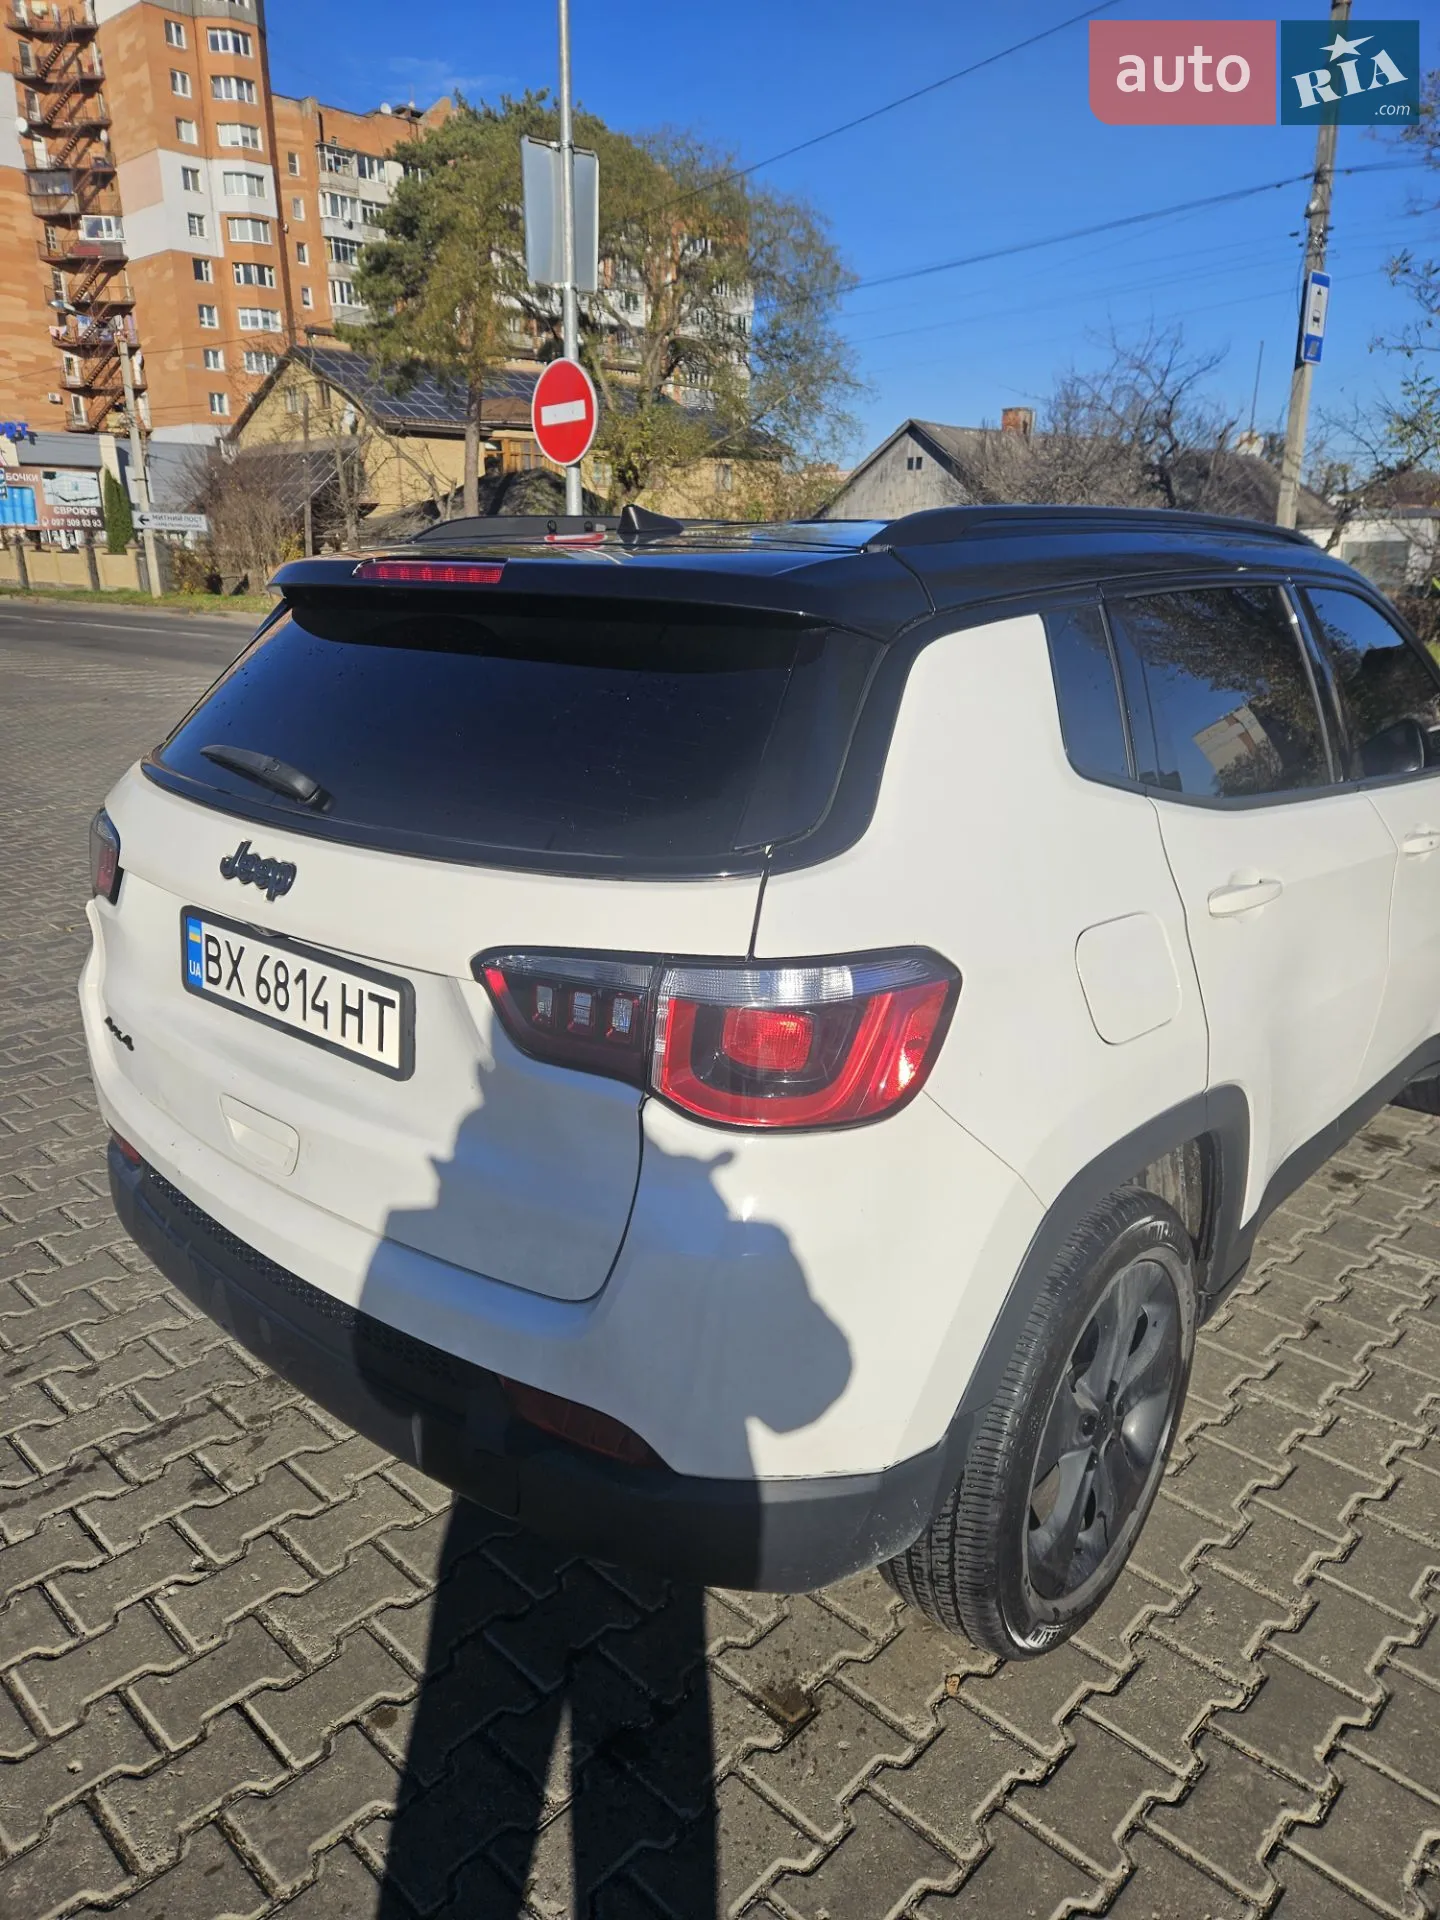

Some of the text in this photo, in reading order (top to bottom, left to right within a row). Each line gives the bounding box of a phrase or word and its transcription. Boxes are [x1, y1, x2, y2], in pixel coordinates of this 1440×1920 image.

[5, 472, 39, 482] БОЧКИ
[219, 840, 297, 902] Jeep
[189, 959, 201, 977] UA
[203, 934, 396, 1053] BX 6814 HT
